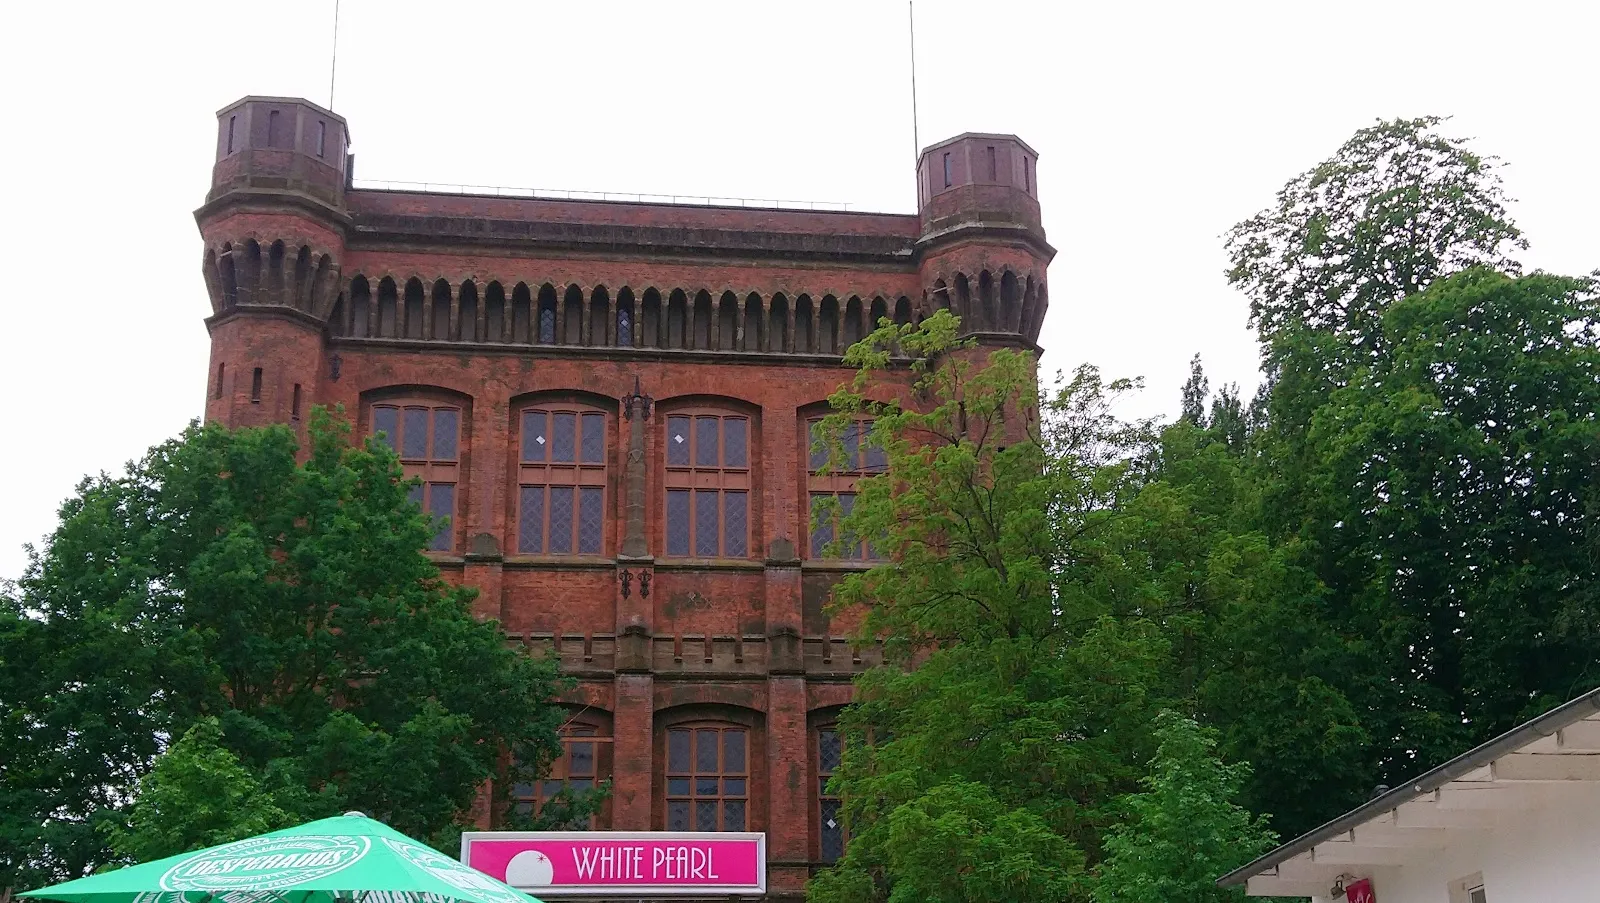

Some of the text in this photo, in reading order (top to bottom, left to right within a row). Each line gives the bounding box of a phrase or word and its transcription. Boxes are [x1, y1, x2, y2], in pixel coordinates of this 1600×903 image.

[183, 849, 344, 876] DESPERADOS
[572, 846, 719, 881] WHITE PEARL
